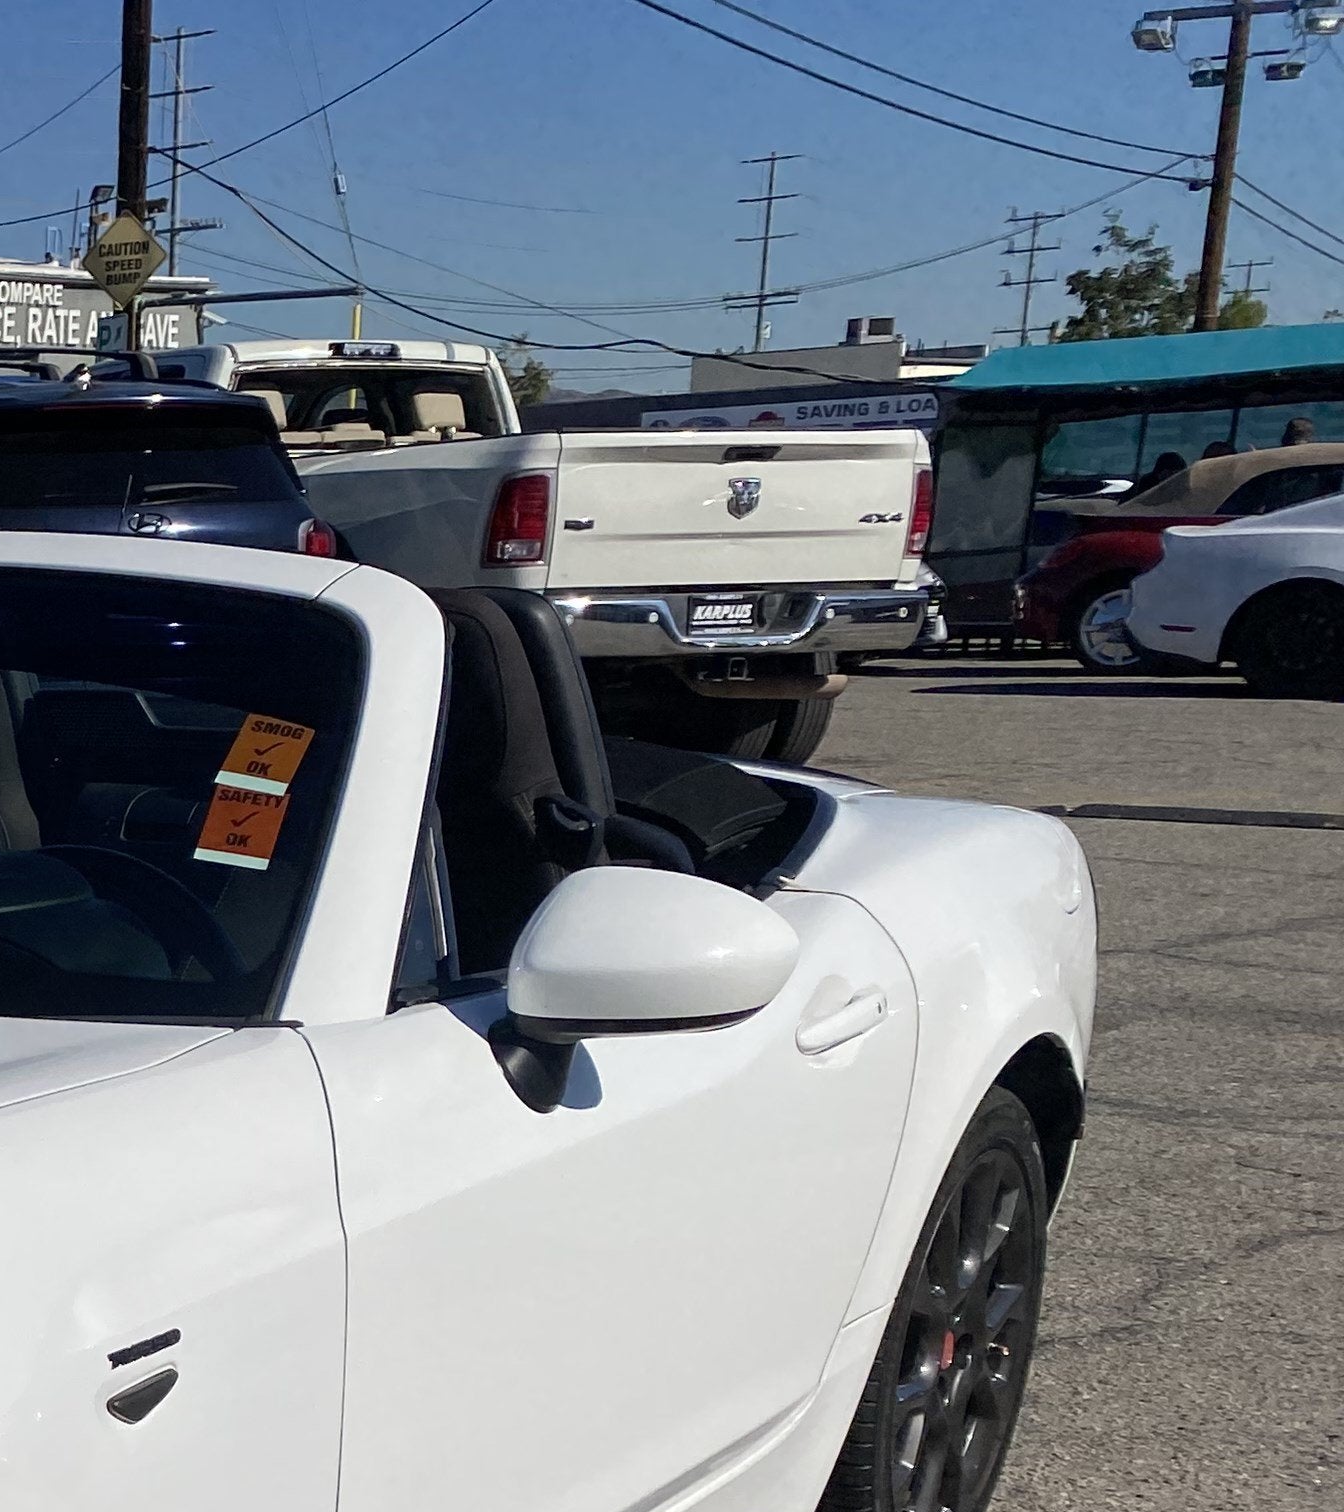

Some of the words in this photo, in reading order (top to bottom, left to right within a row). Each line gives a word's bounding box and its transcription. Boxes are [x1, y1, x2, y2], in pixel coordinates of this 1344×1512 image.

[98, 241, 150, 257] CAUTION
[105, 258, 142, 272] SPEED
[105, 272, 141, 286] BUMP
[27, 307, 81, 345] RATE
[796, 403, 870, 420] SAVING
[878, 401, 889, 414] &
[693, 603, 753, 620] KARPLUS
[251, 720, 306, 740] SMOG
[246, 760, 272, 776] OK
[218, 789, 285, 808] SAFETY
[225, 833, 252, 848] OK
